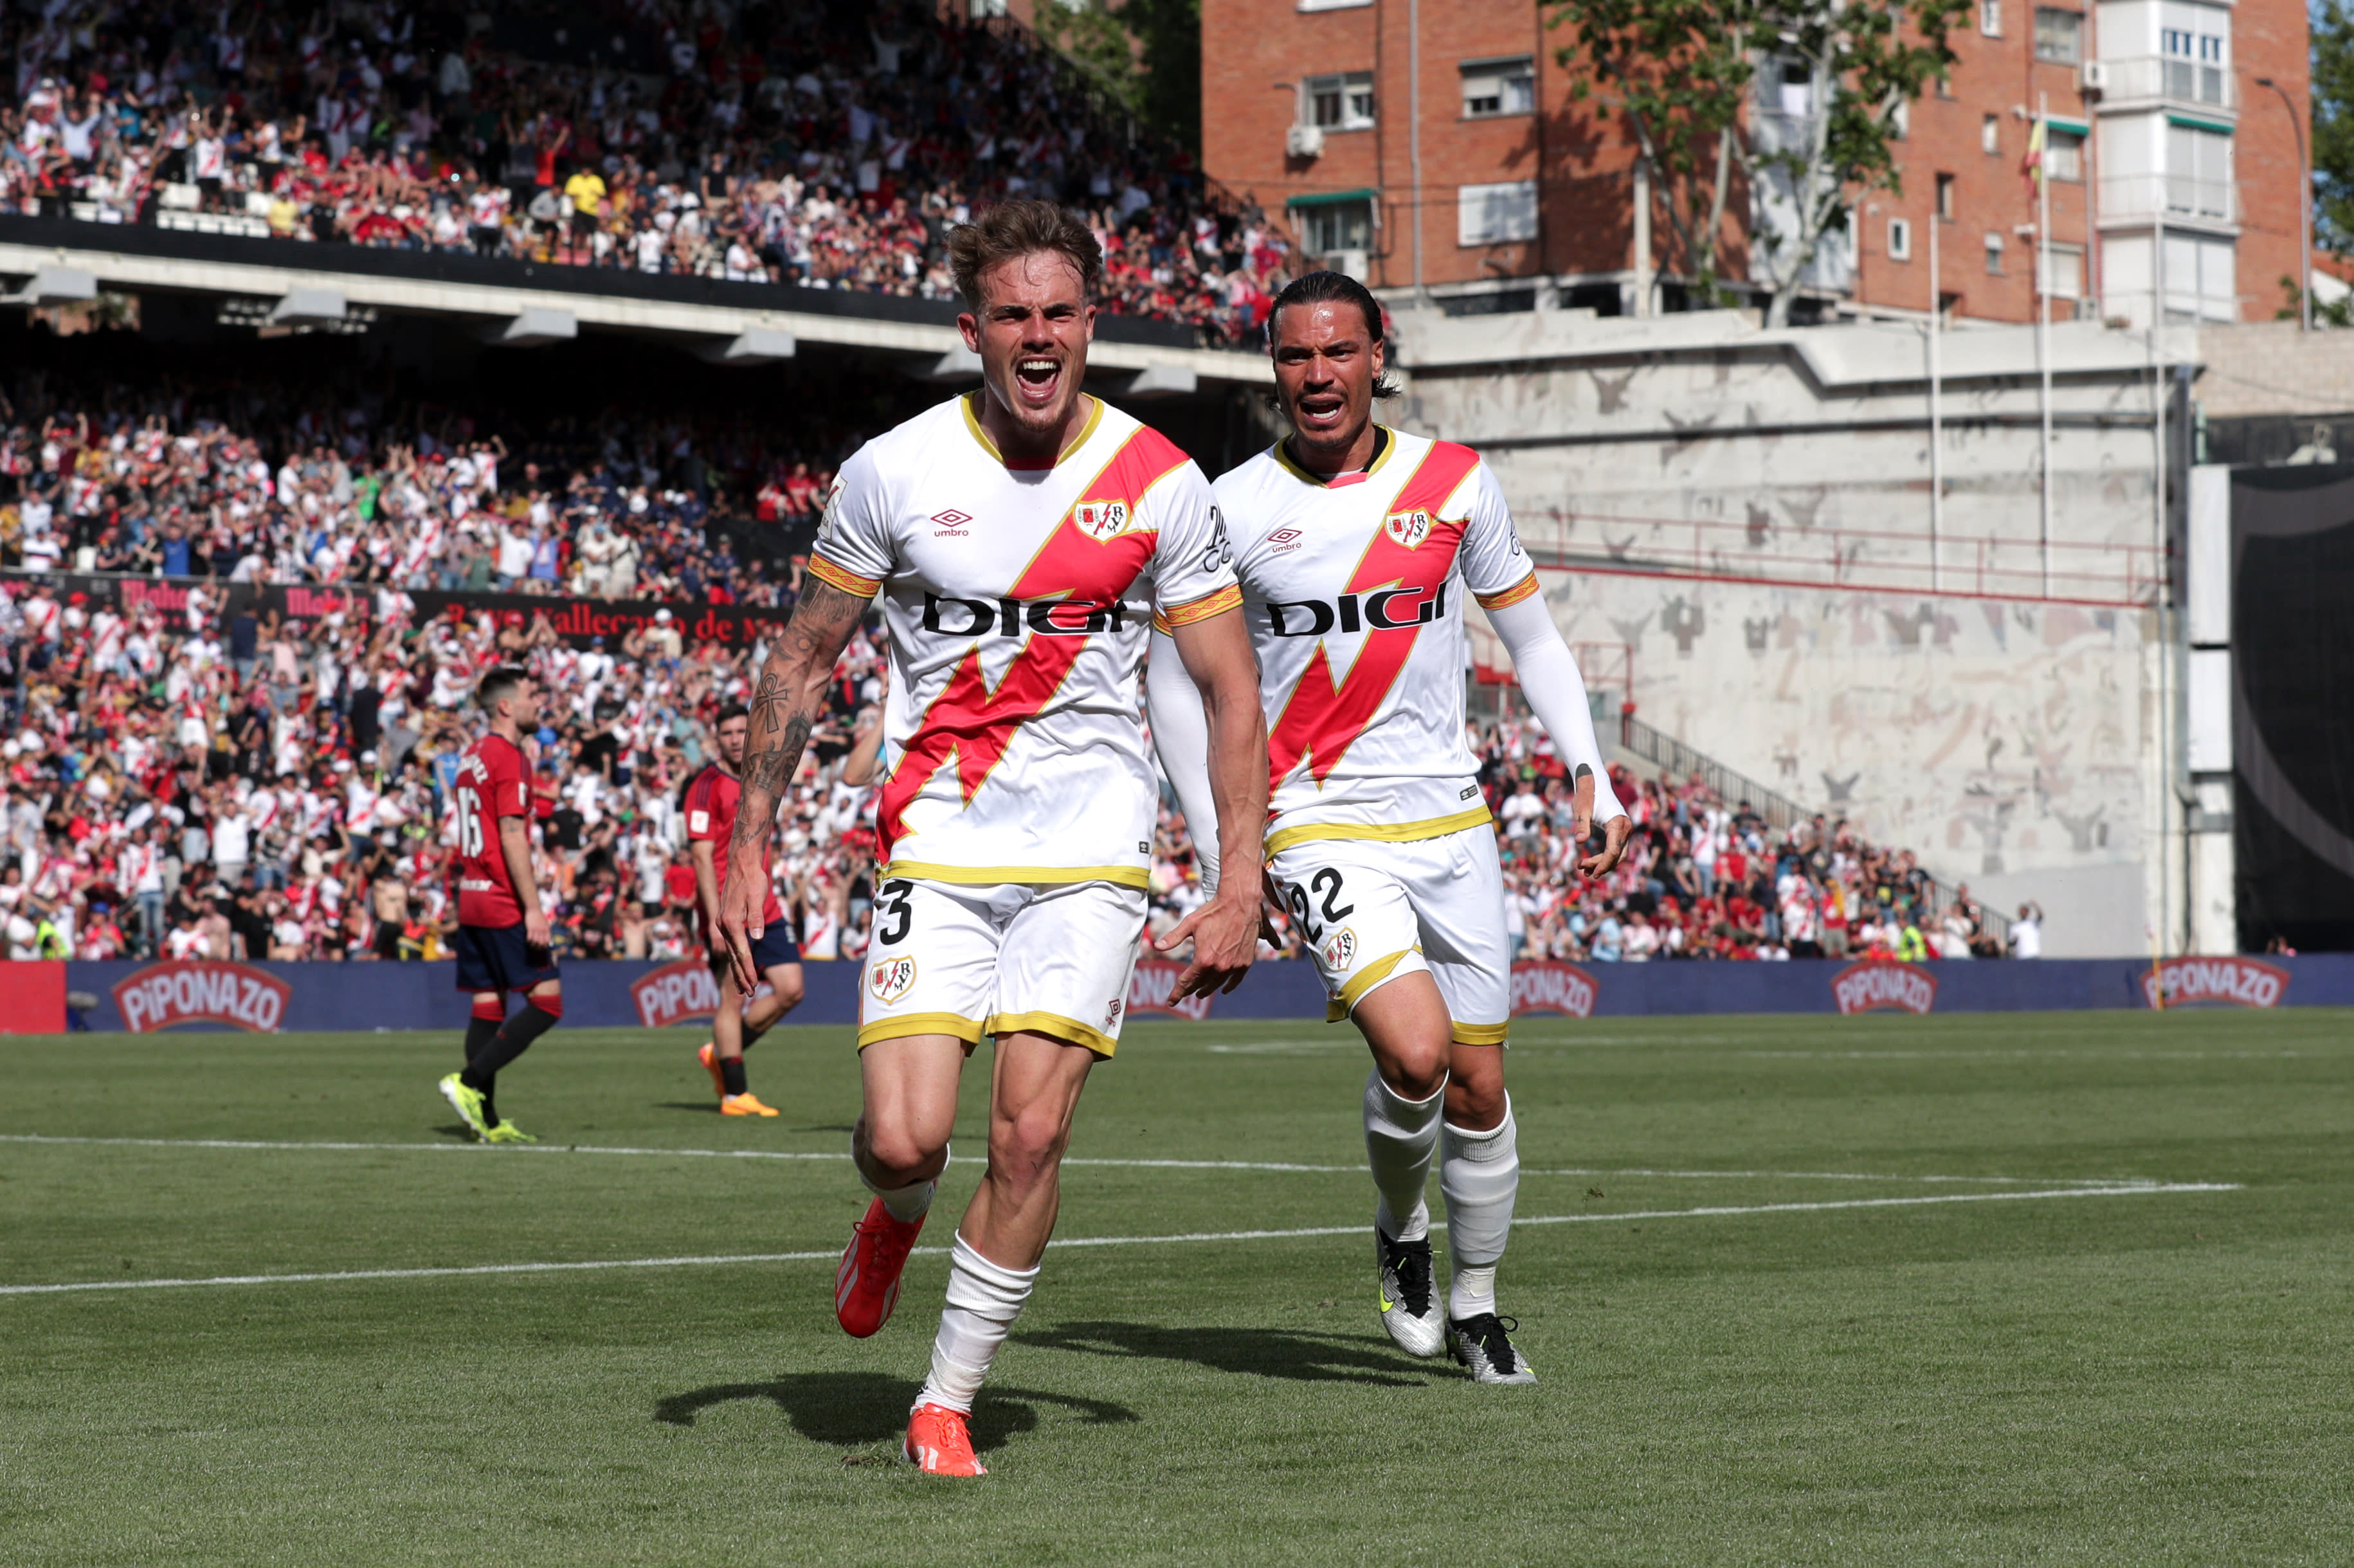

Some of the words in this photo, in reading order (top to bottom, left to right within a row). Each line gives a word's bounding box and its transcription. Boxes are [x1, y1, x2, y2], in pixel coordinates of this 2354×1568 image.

[934, 528, 968, 537] umbro
[1272, 543, 1302, 553] umbro
[694, 609, 734, 642] de
[922, 591, 1127, 636] DIGI
[1266, 581, 1446, 637] DIGI
[457, 786, 484, 858] 16
[880, 879, 913, 945] 3
[1291, 867, 1354, 946] 22
[1512, 968, 1593, 1018] PONAZO
